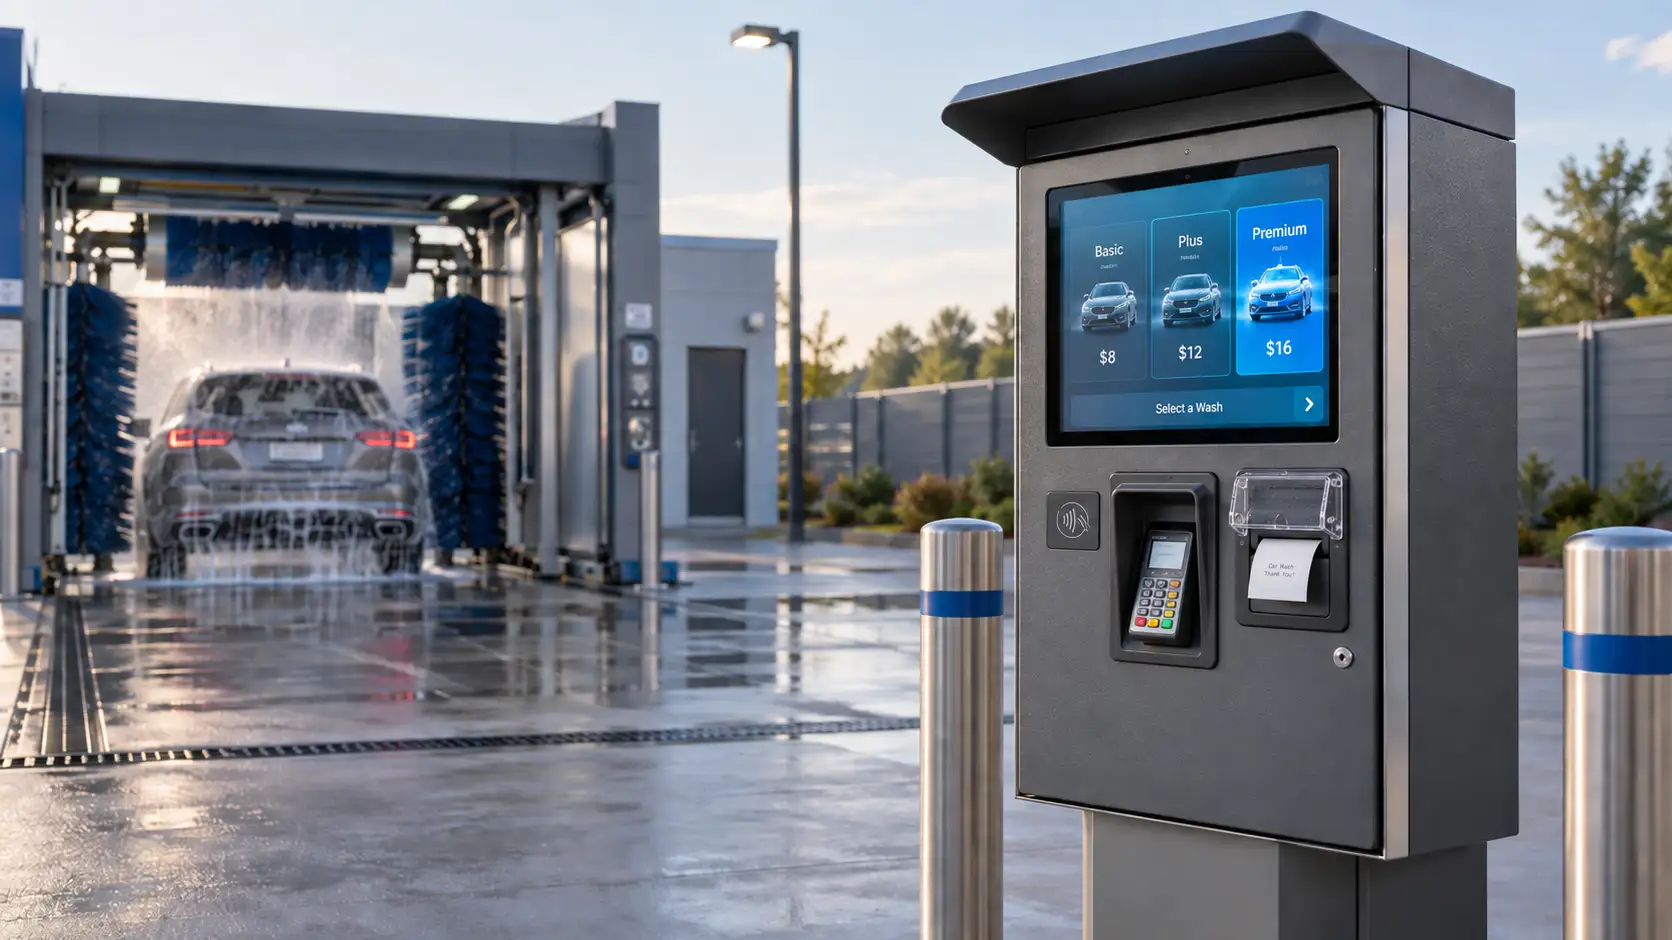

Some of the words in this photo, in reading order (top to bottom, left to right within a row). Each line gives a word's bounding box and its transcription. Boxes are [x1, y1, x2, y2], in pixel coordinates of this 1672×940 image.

[1252, 224, 1307, 240] Premium
[1178, 234, 1203, 248] Plus
[1095, 244, 1124, 258] Basic
[1178, 345, 1203, 361] $12
[1266, 340, 1292, 357] $16
[1100, 350, 1116, 365] $8
[1156, 403, 1186, 415] Select
[1187, 405, 1194, 413] a
[1196, 401, 1223, 413] Wash
